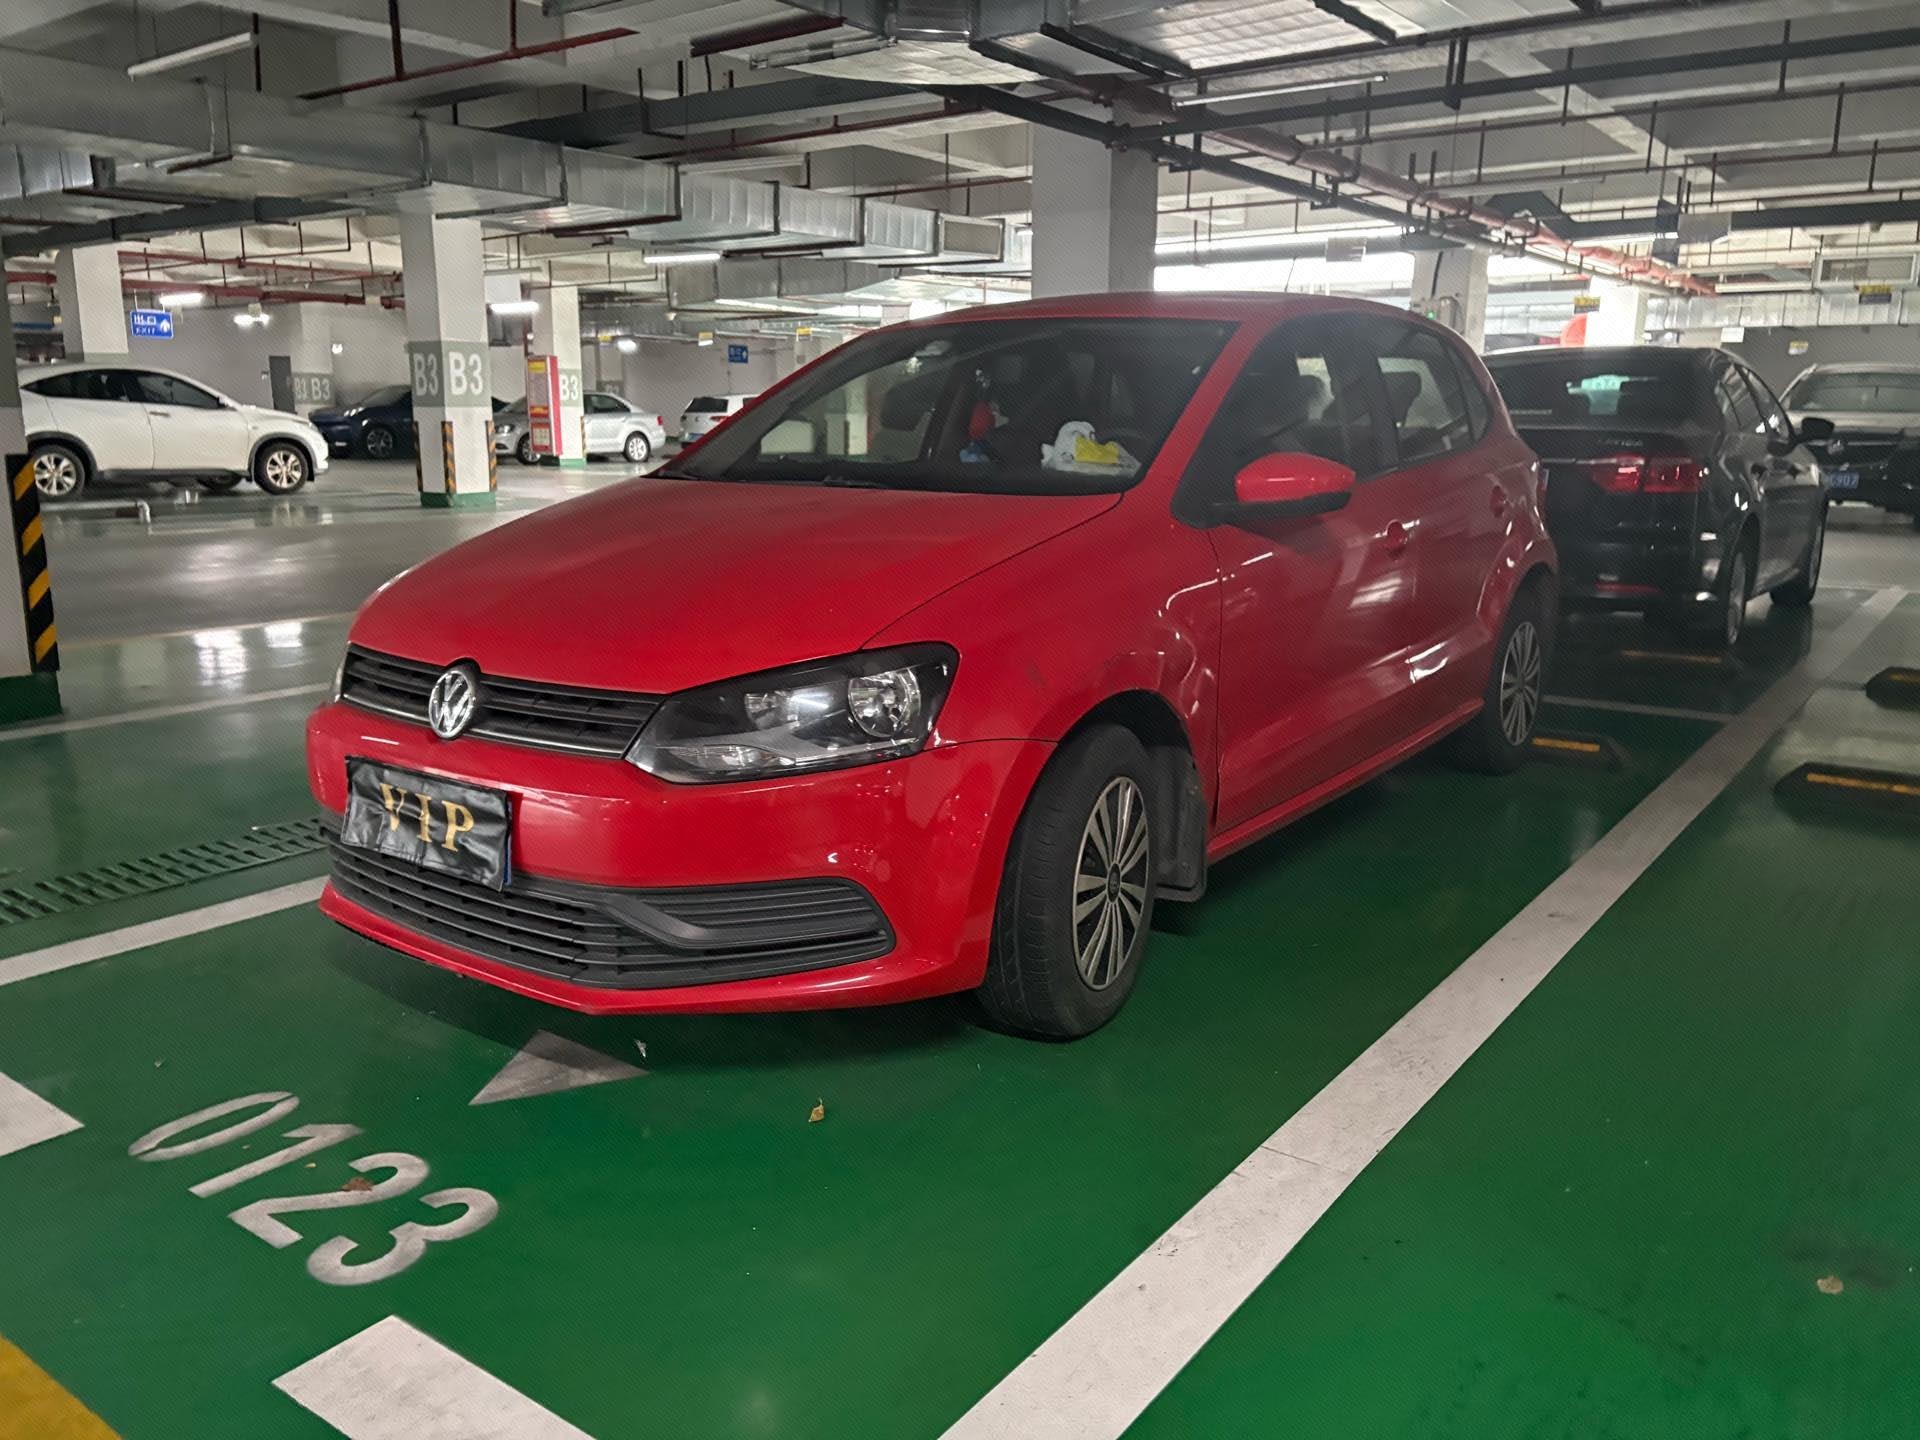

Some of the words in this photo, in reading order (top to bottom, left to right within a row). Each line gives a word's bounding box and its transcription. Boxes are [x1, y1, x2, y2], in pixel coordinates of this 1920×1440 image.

[133, 314, 157, 325] 出口
[311, 377, 330, 400] B3
[413, 352, 439, 396] B3
[448, 351, 483, 396] B3
[559, 373, 579, 401] B3
[379, 782, 475, 852] VIP
[128, 1091, 498, 1286] 0123
